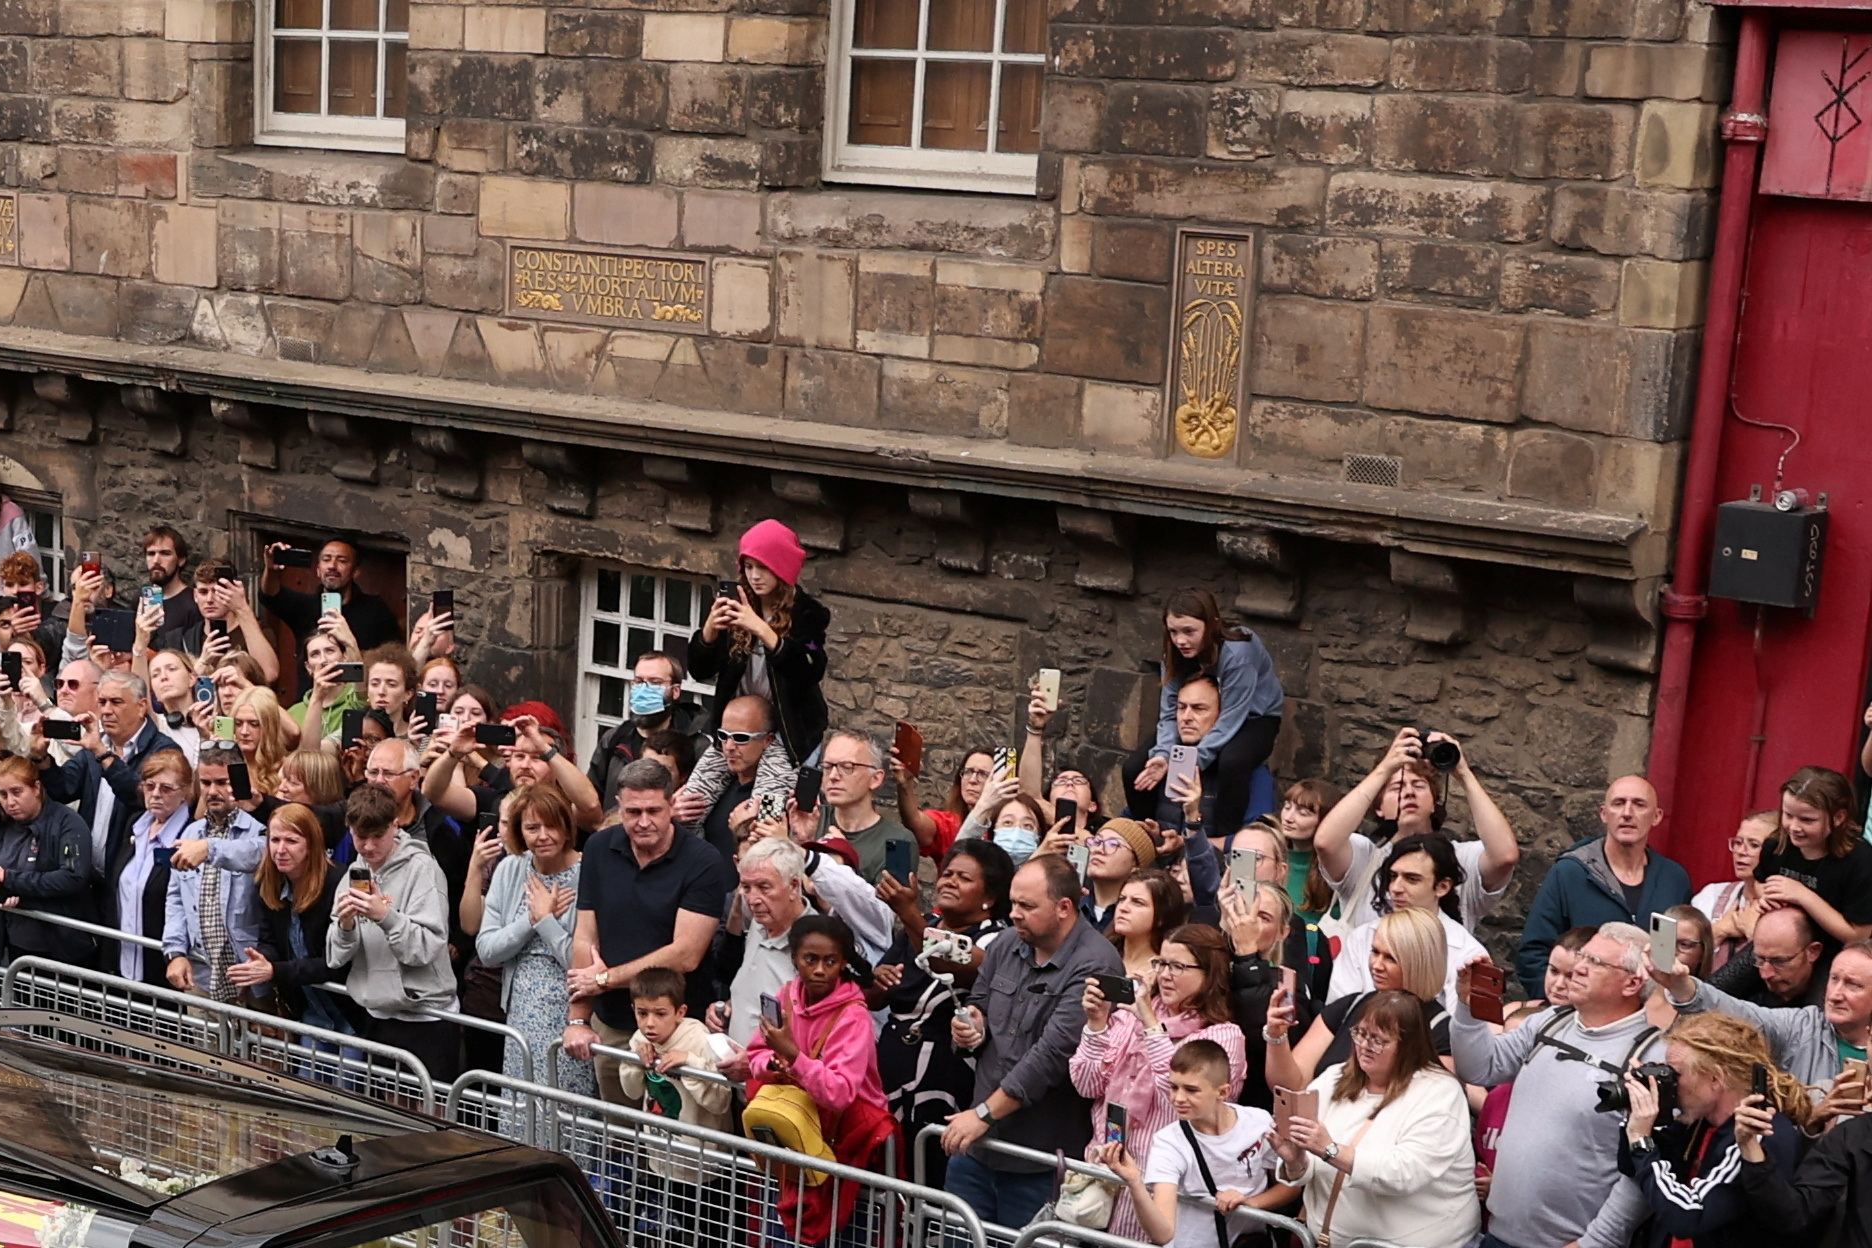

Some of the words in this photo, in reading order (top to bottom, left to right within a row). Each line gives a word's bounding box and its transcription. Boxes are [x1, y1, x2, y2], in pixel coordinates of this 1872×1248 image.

[1196, 239, 1238, 258] SPES
[514, 250, 618, 277] CONSTANTI
[622, 260, 704, 284] PECTORI
[1186, 260, 1246, 279] ALTERA
[521, 271, 558, 292] RES
[580, 276, 696, 304] MORTALIVM
[1195, 279, 1238, 297] VITÆ
[571, 293, 644, 320] VMBRA
